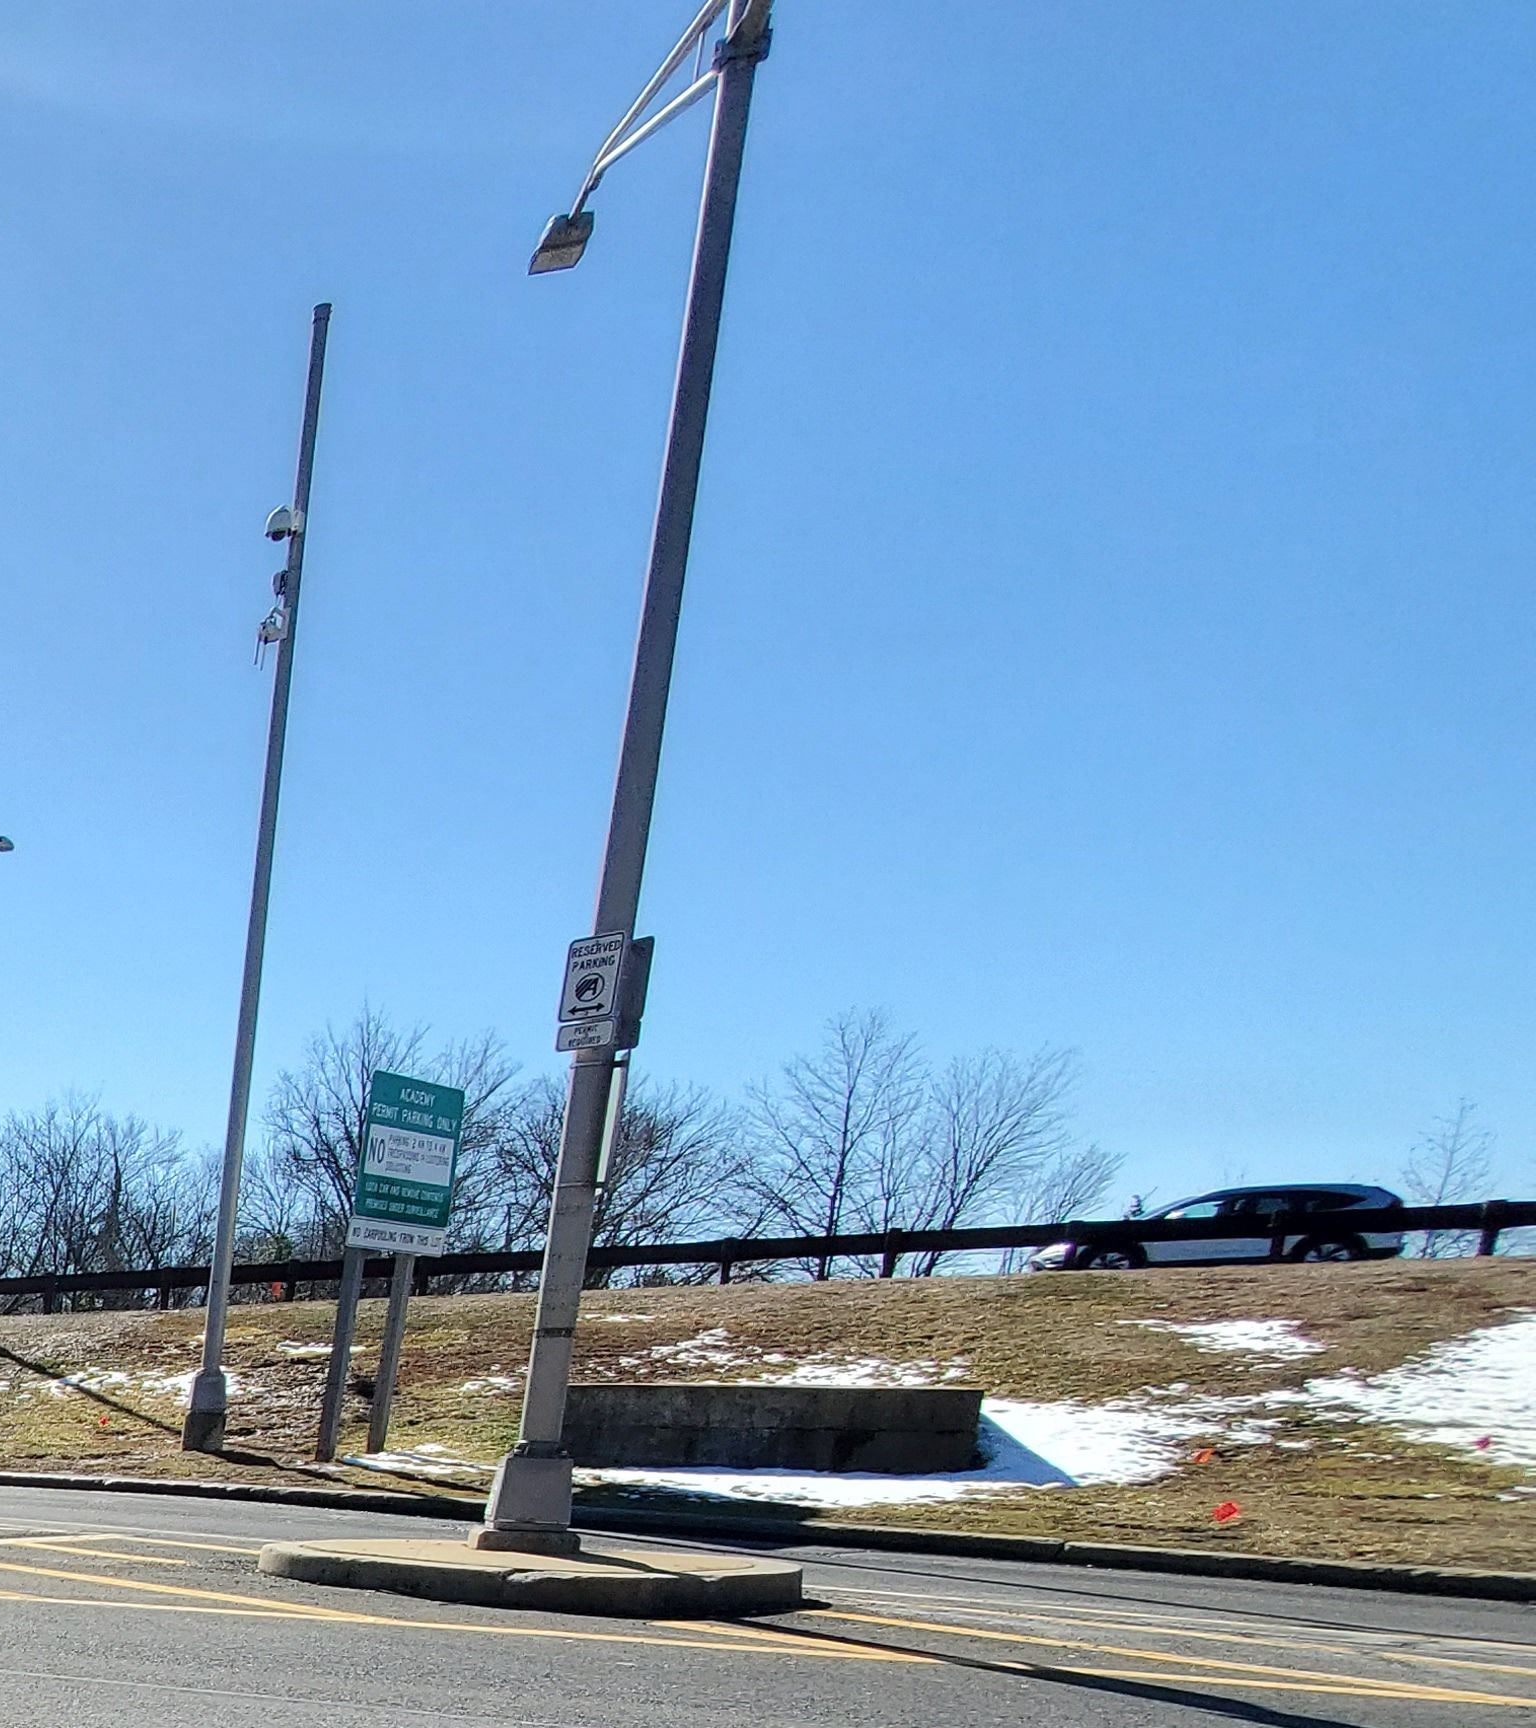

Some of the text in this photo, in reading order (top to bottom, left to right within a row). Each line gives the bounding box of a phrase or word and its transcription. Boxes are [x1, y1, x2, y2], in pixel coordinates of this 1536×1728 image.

[572, 940, 621, 959] RESERVED
[573, 956, 616, 972] PARKING
[400, 1089, 436, 1108] ACADEMY
[372, 1103, 458, 1132] PERMIT PARKING ONLY
[369, 1137, 386, 1164] NO
